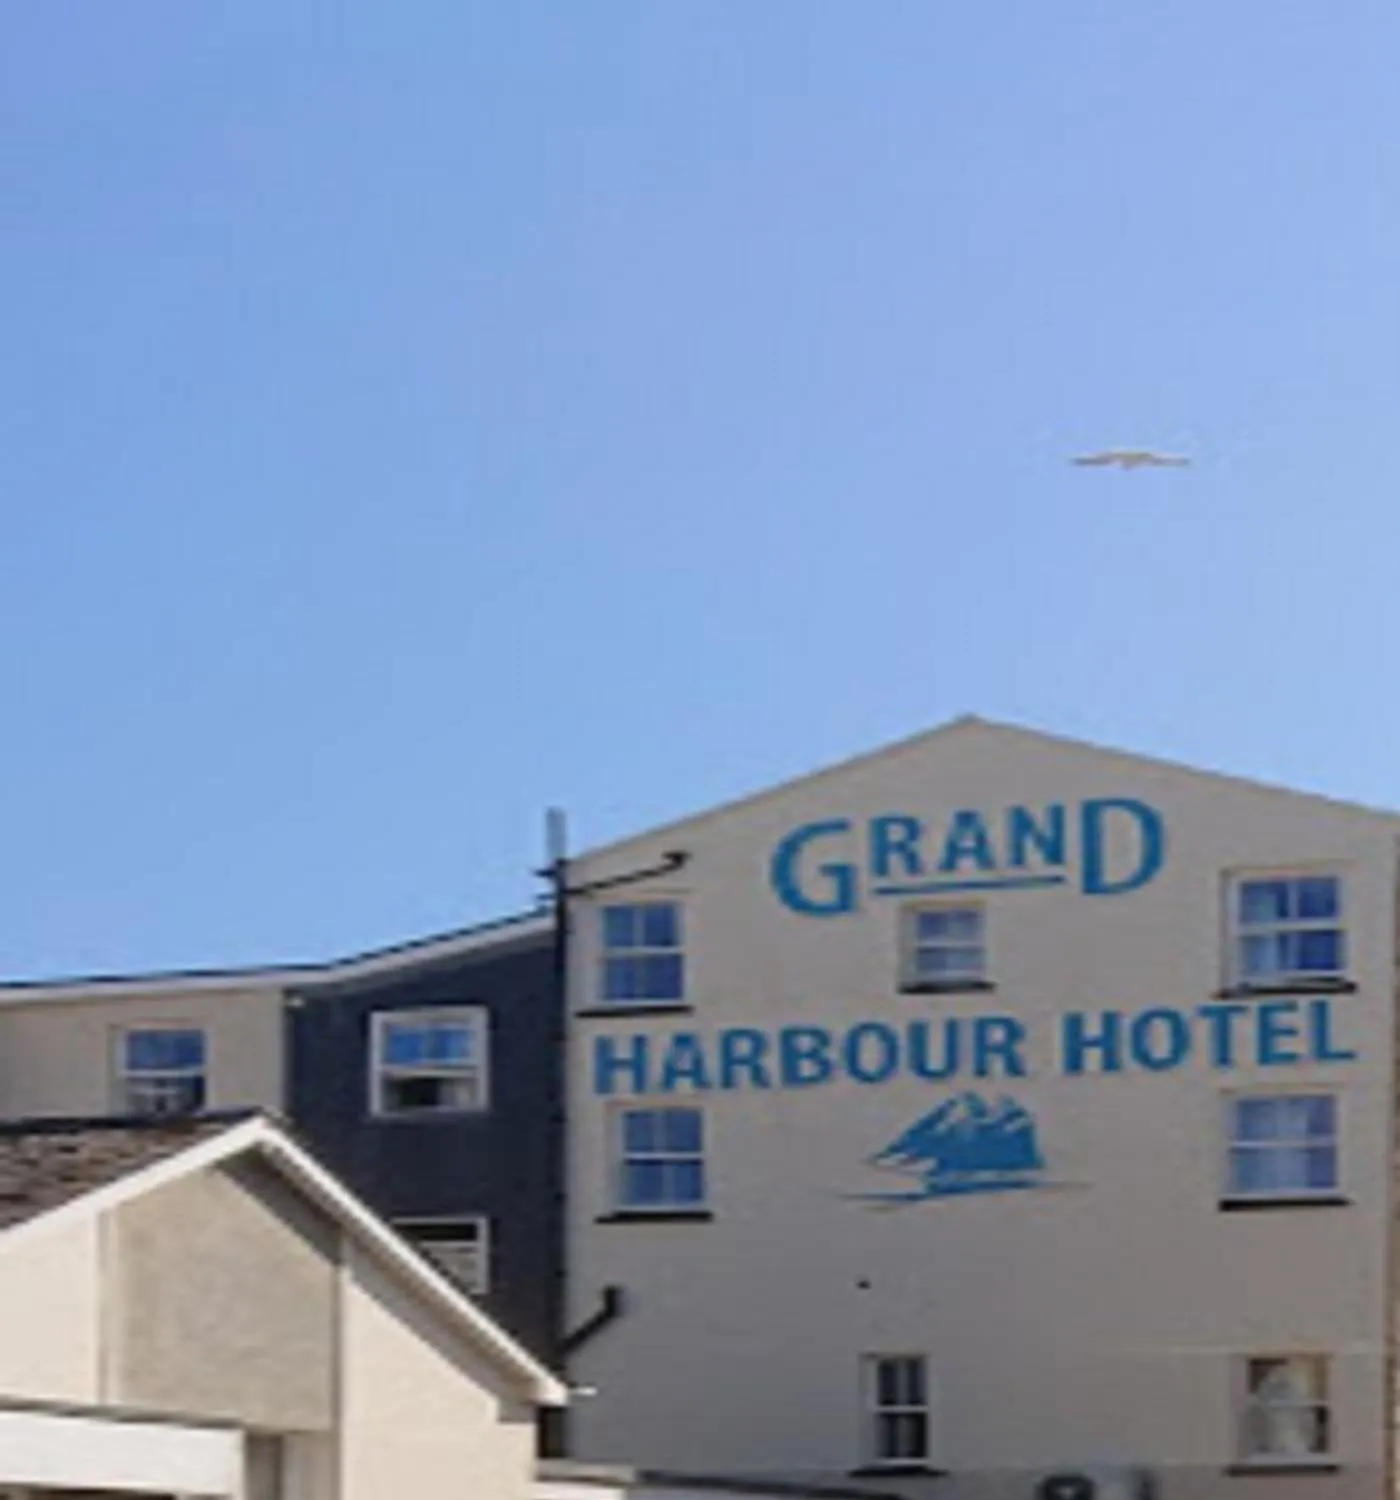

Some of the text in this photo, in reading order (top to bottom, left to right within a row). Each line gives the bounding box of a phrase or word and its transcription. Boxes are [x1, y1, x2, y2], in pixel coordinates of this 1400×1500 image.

[771, 798, 1165, 917] GRAND
[594, 1001, 1356, 1096] HARBOUR HOTEL
